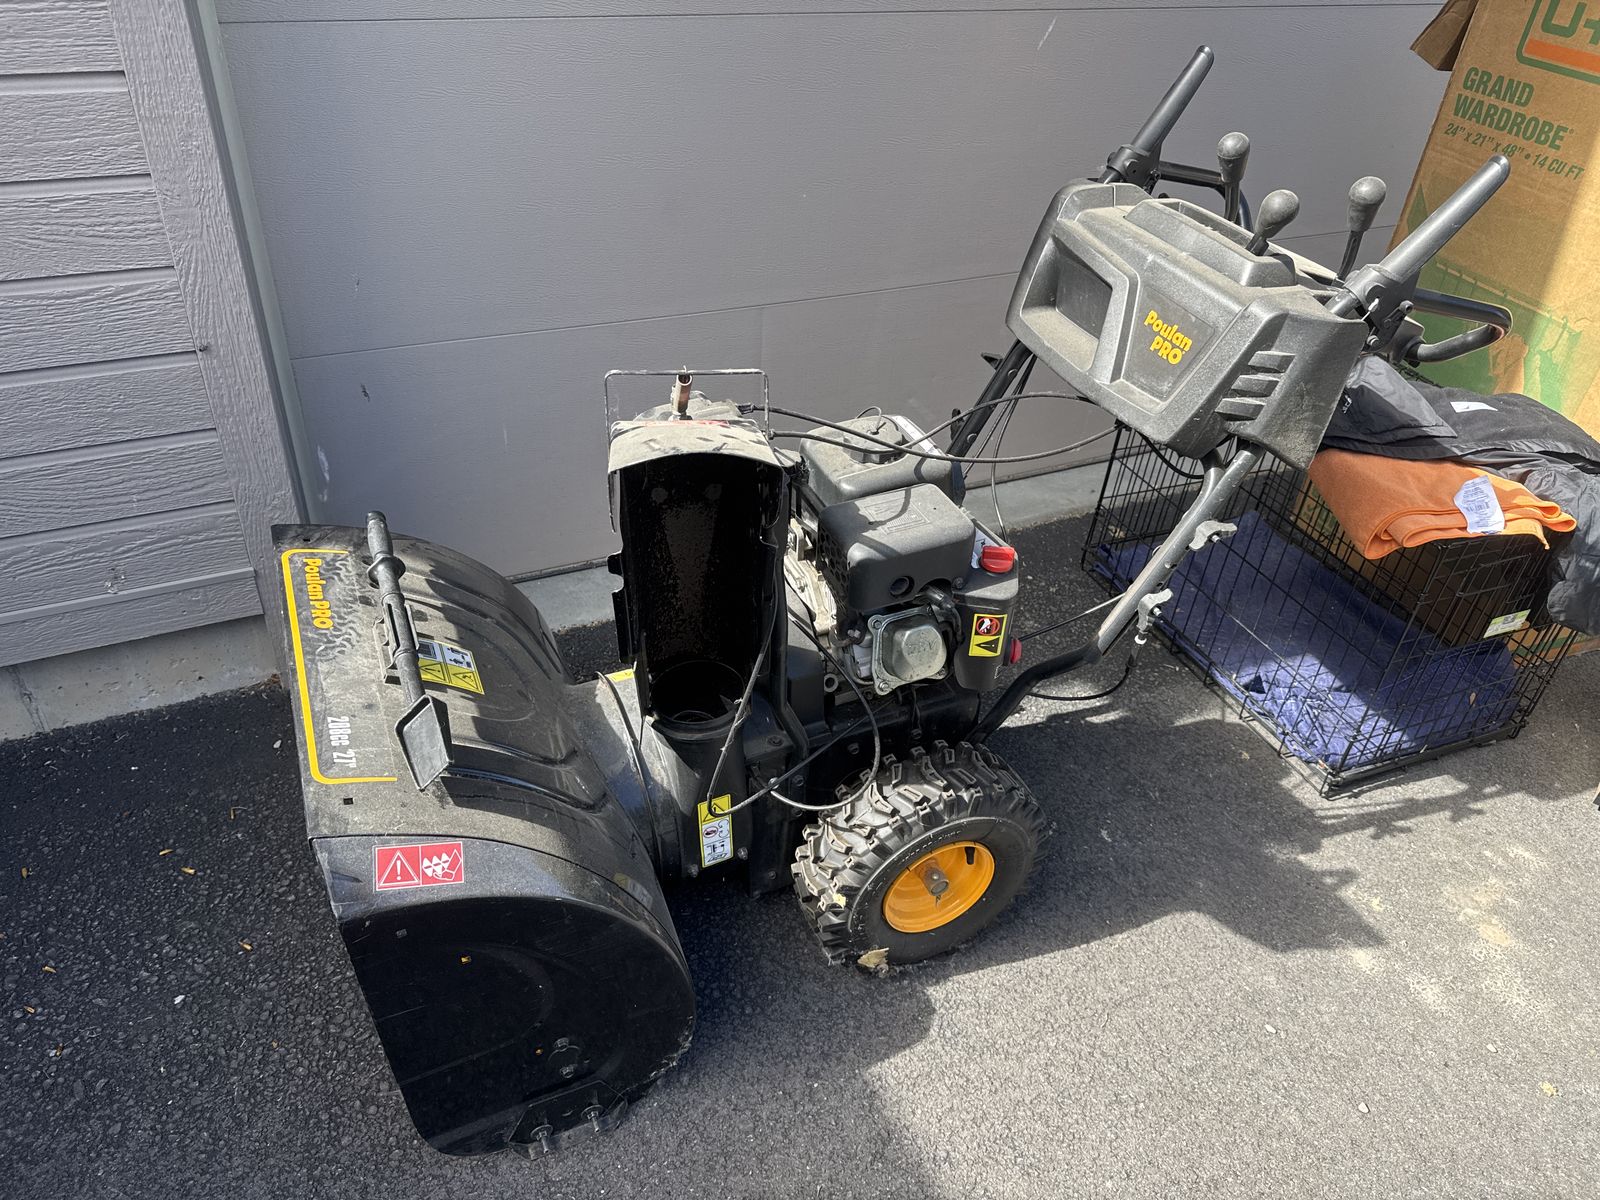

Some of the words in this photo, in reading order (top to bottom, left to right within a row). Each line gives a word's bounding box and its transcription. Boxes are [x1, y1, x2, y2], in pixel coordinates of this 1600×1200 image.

[1463, 67, 1534, 107] GRAND
[1453, 93, 1569, 151] WARDROBE
[1532, 154, 1547, 168] 14
[1548, 158, 1567, 174] CU
[1565, 168, 1585, 180] FT
[1144, 310, 1192, 351] Poulan
[1150, 336, 1182, 364] PRO
[303, 558, 326, 601] Poulan
[312, 601, 334, 629] PRO
